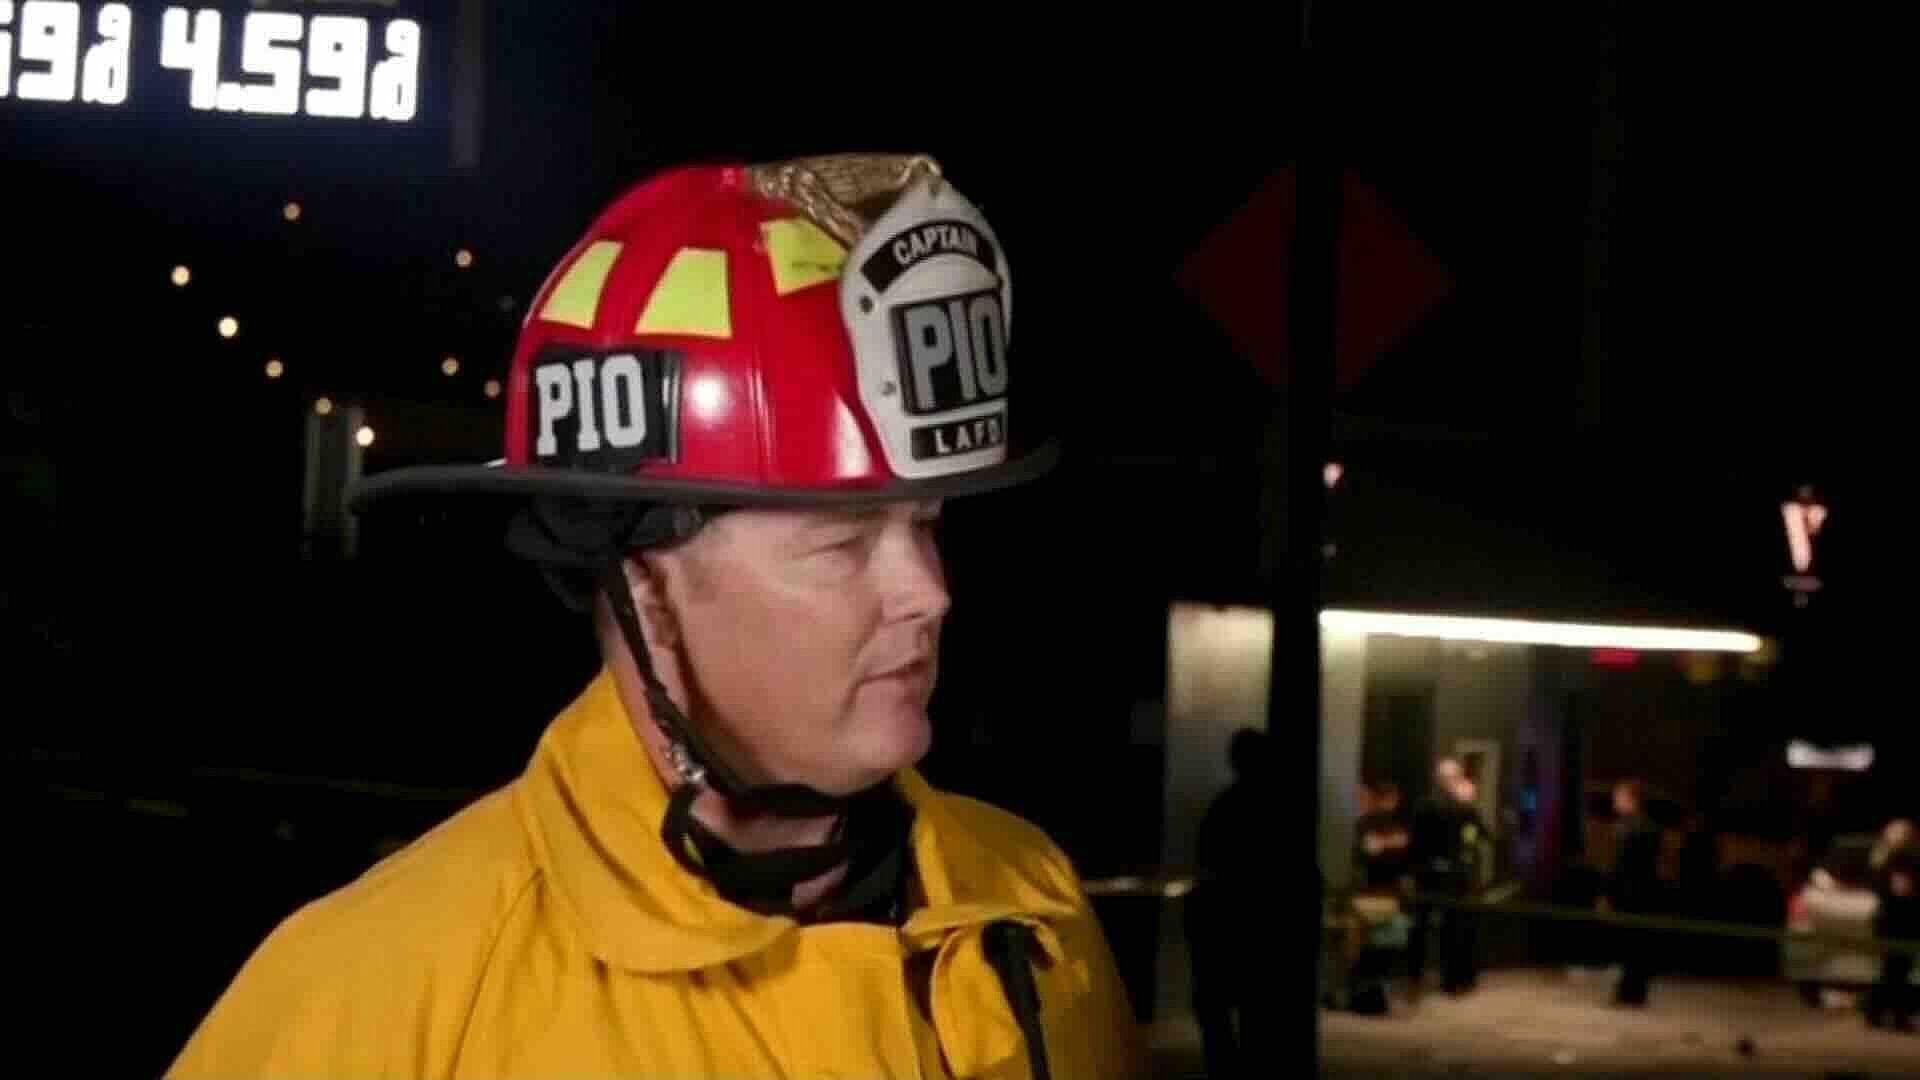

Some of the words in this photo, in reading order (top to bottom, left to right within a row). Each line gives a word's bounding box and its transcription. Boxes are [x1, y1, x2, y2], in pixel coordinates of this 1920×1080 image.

[892, 223, 978, 265] CAPTAIN
[904, 296, 1008, 411] PIO
[535, 354, 647, 457] PIO
